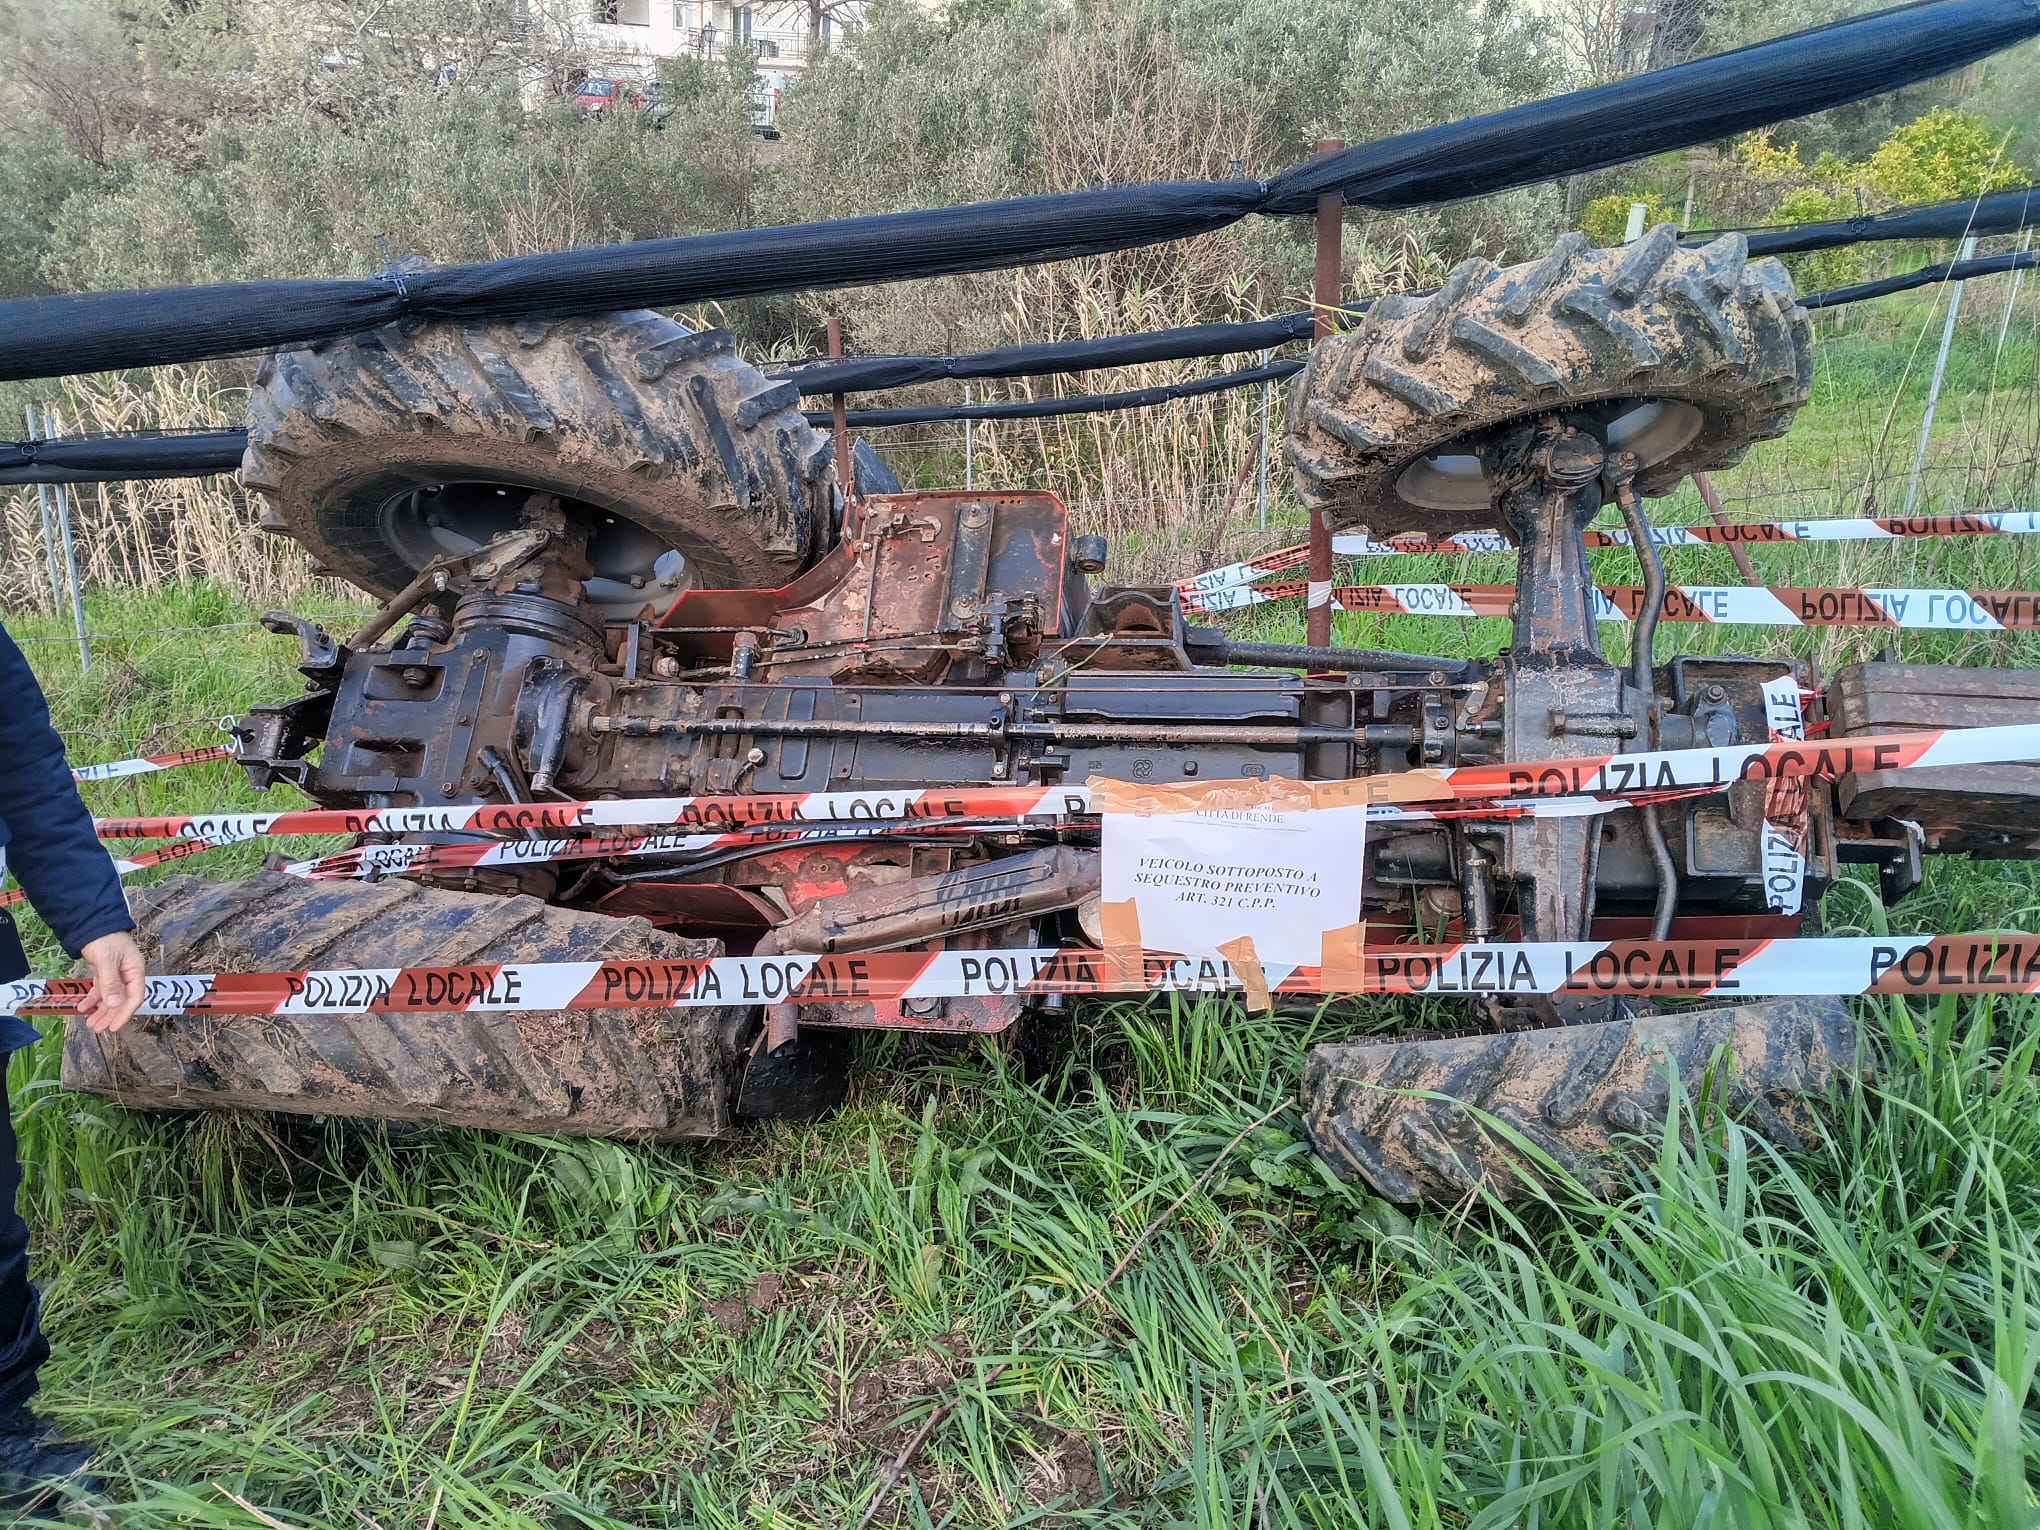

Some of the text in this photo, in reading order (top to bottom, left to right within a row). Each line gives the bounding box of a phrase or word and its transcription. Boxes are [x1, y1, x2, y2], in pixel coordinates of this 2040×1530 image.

[1246, 812, 1284, 824] RENDE
[1139, 857, 1318, 882] VEICOLO SOTTOPOSTO A
[1134, 872, 1321, 898] SEQUESTRO PREVENTIVO
[1175, 891, 1208, 904] ART.
[1211, 895, 1233, 908] 321
[285, 975, 391, 1007] POLIZIA
[407, 970, 522, 1006] LOCALE
[603, 965, 722, 1001] POLIZIA
[741, 959, 870, 999] LOCALE
[963, 957, 1102, 995] POLIZIA
[1378, 952, 1538, 991] POLIZIA
[1565, 947, 1741, 989] LOCALE
[1871, 942, 2040, 985] POLIZIA
